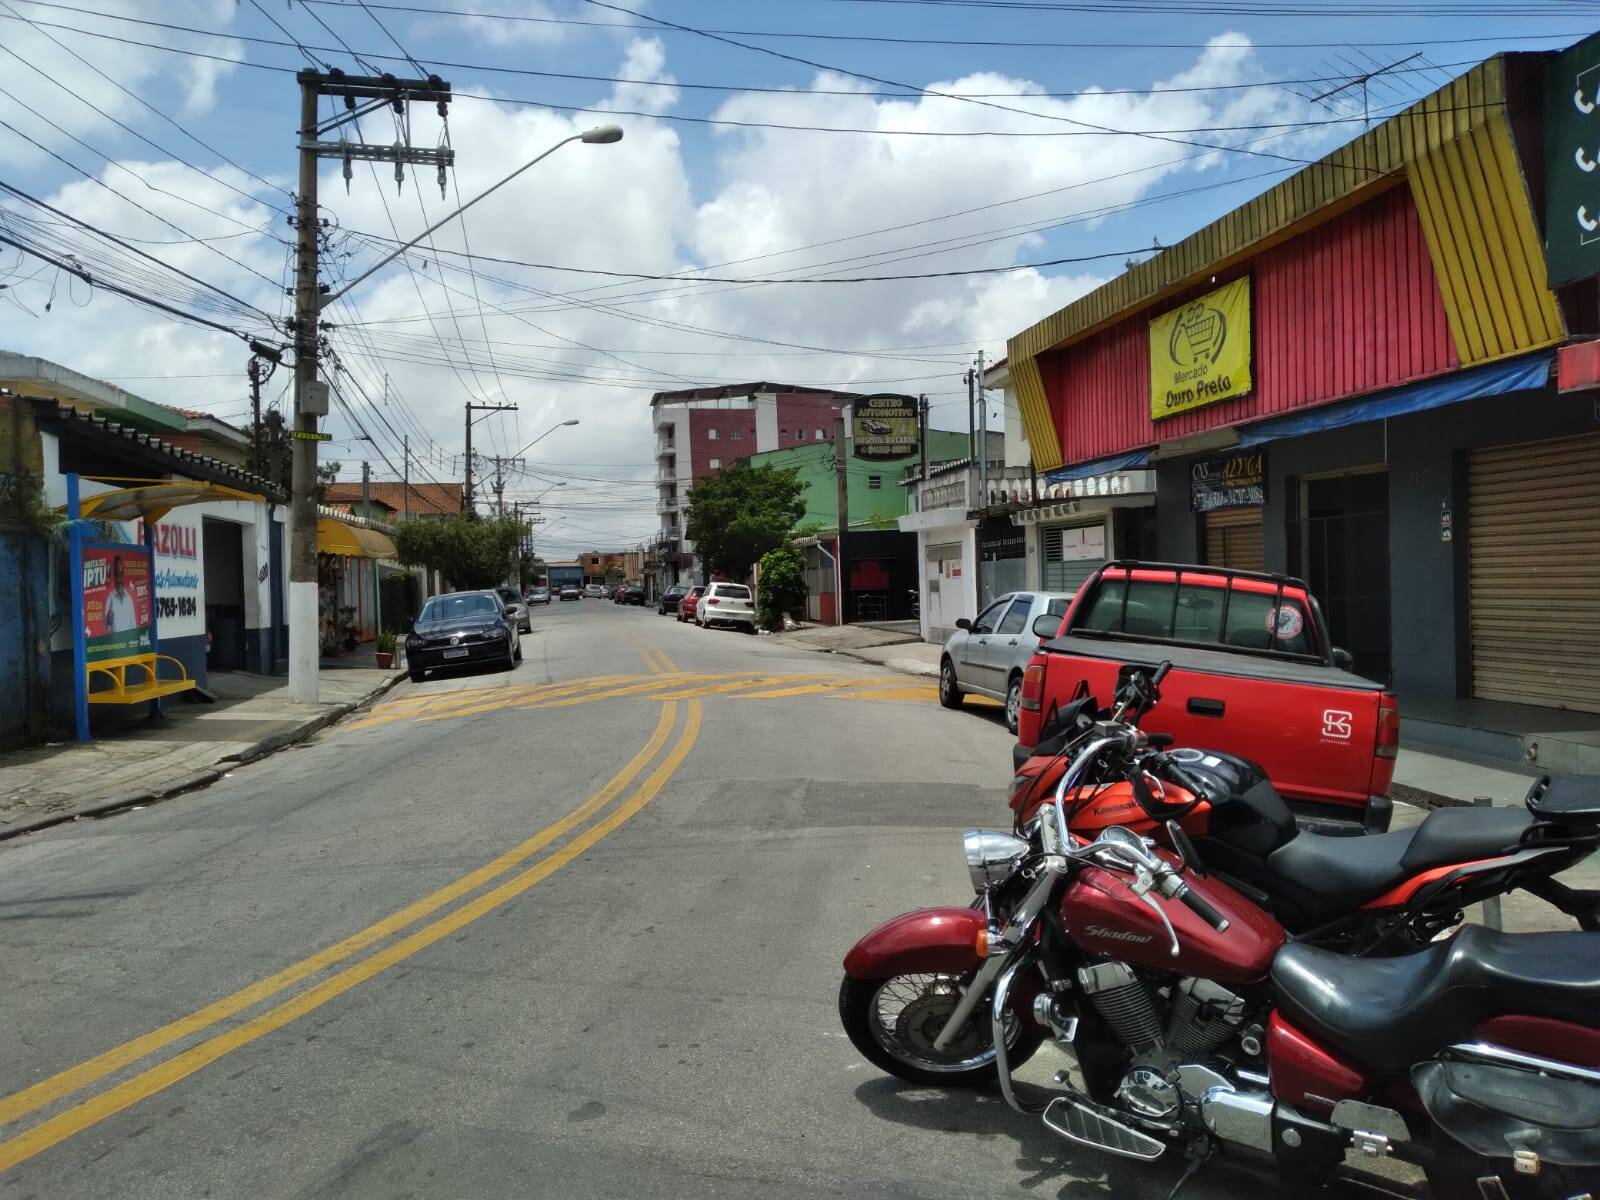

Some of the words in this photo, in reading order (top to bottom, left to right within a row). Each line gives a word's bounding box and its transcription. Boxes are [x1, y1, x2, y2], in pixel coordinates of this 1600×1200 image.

[1174, 363, 1208, 384] Mercado
[1165, 388, 1195, 408] Ouro
[1196, 375, 1232, 400] Preto
[857, 408, 914, 417] AUTOMOTIVO
[869, 398, 904, 408] CENTRO
[1084, 924, 1153, 943] Shadow
